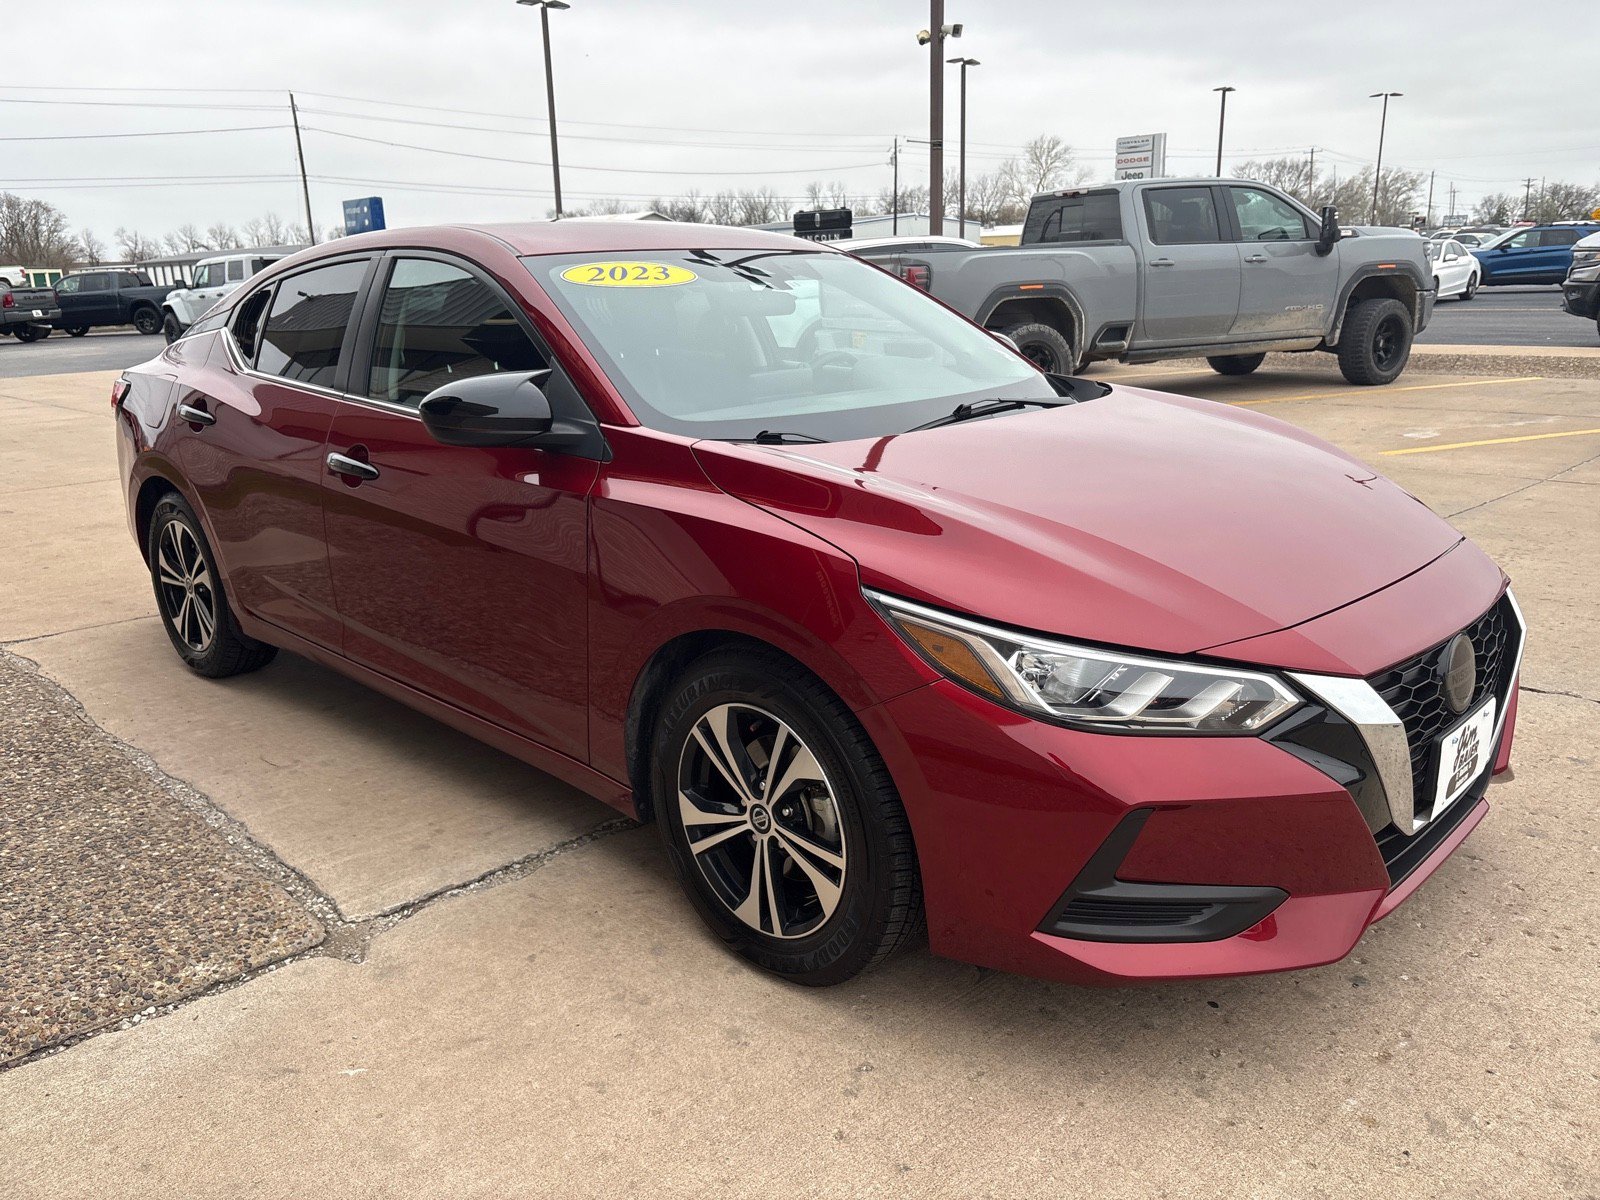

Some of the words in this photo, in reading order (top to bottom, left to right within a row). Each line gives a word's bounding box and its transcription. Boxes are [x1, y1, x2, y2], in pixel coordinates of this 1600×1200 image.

[1117, 156, 1149, 164] DODGE
[1121, 171, 1143, 180] Jeep
[587, 266, 670, 281] 2023
